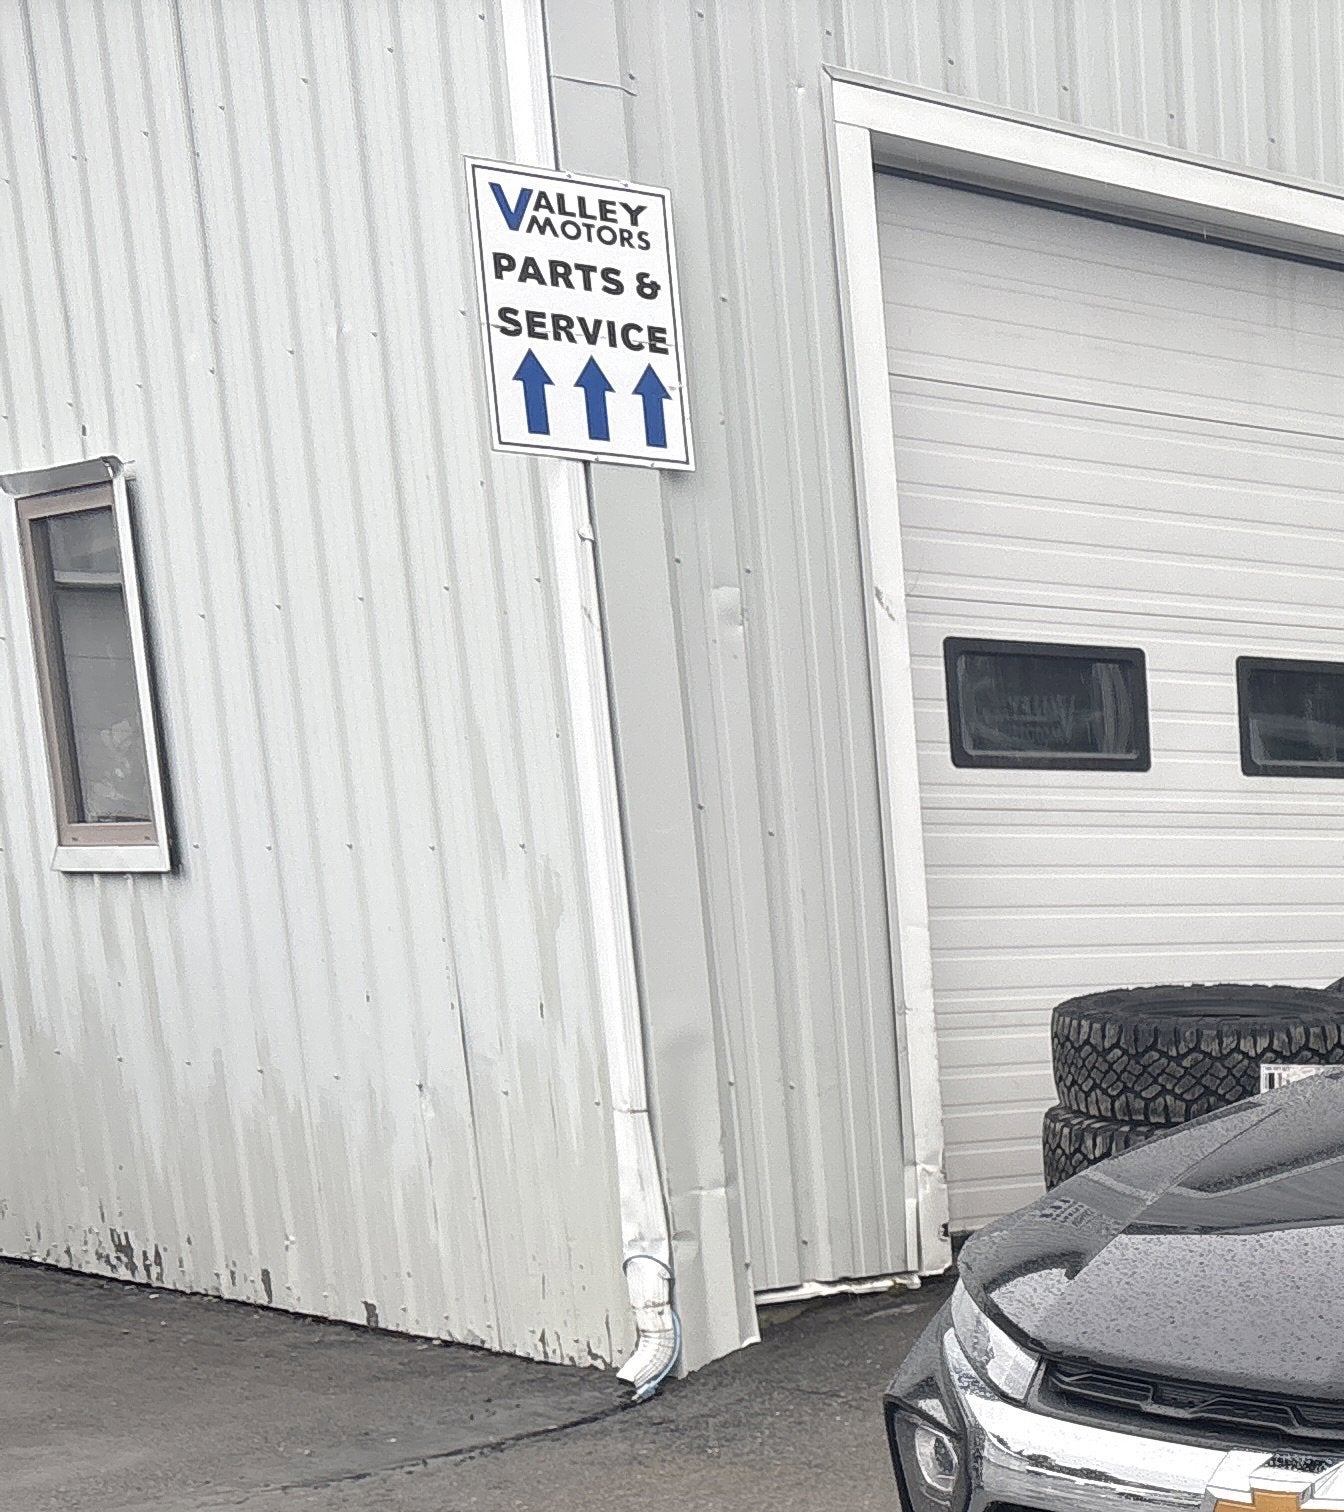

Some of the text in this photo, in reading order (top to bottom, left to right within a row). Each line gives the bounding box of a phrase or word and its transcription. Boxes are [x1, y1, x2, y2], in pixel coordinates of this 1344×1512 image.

[488, 182, 648, 231] VALLEY
[526, 215, 651, 251] MOTORS
[492, 252, 661, 300] PARTS &
[497, 306, 669, 355] SERVICE
